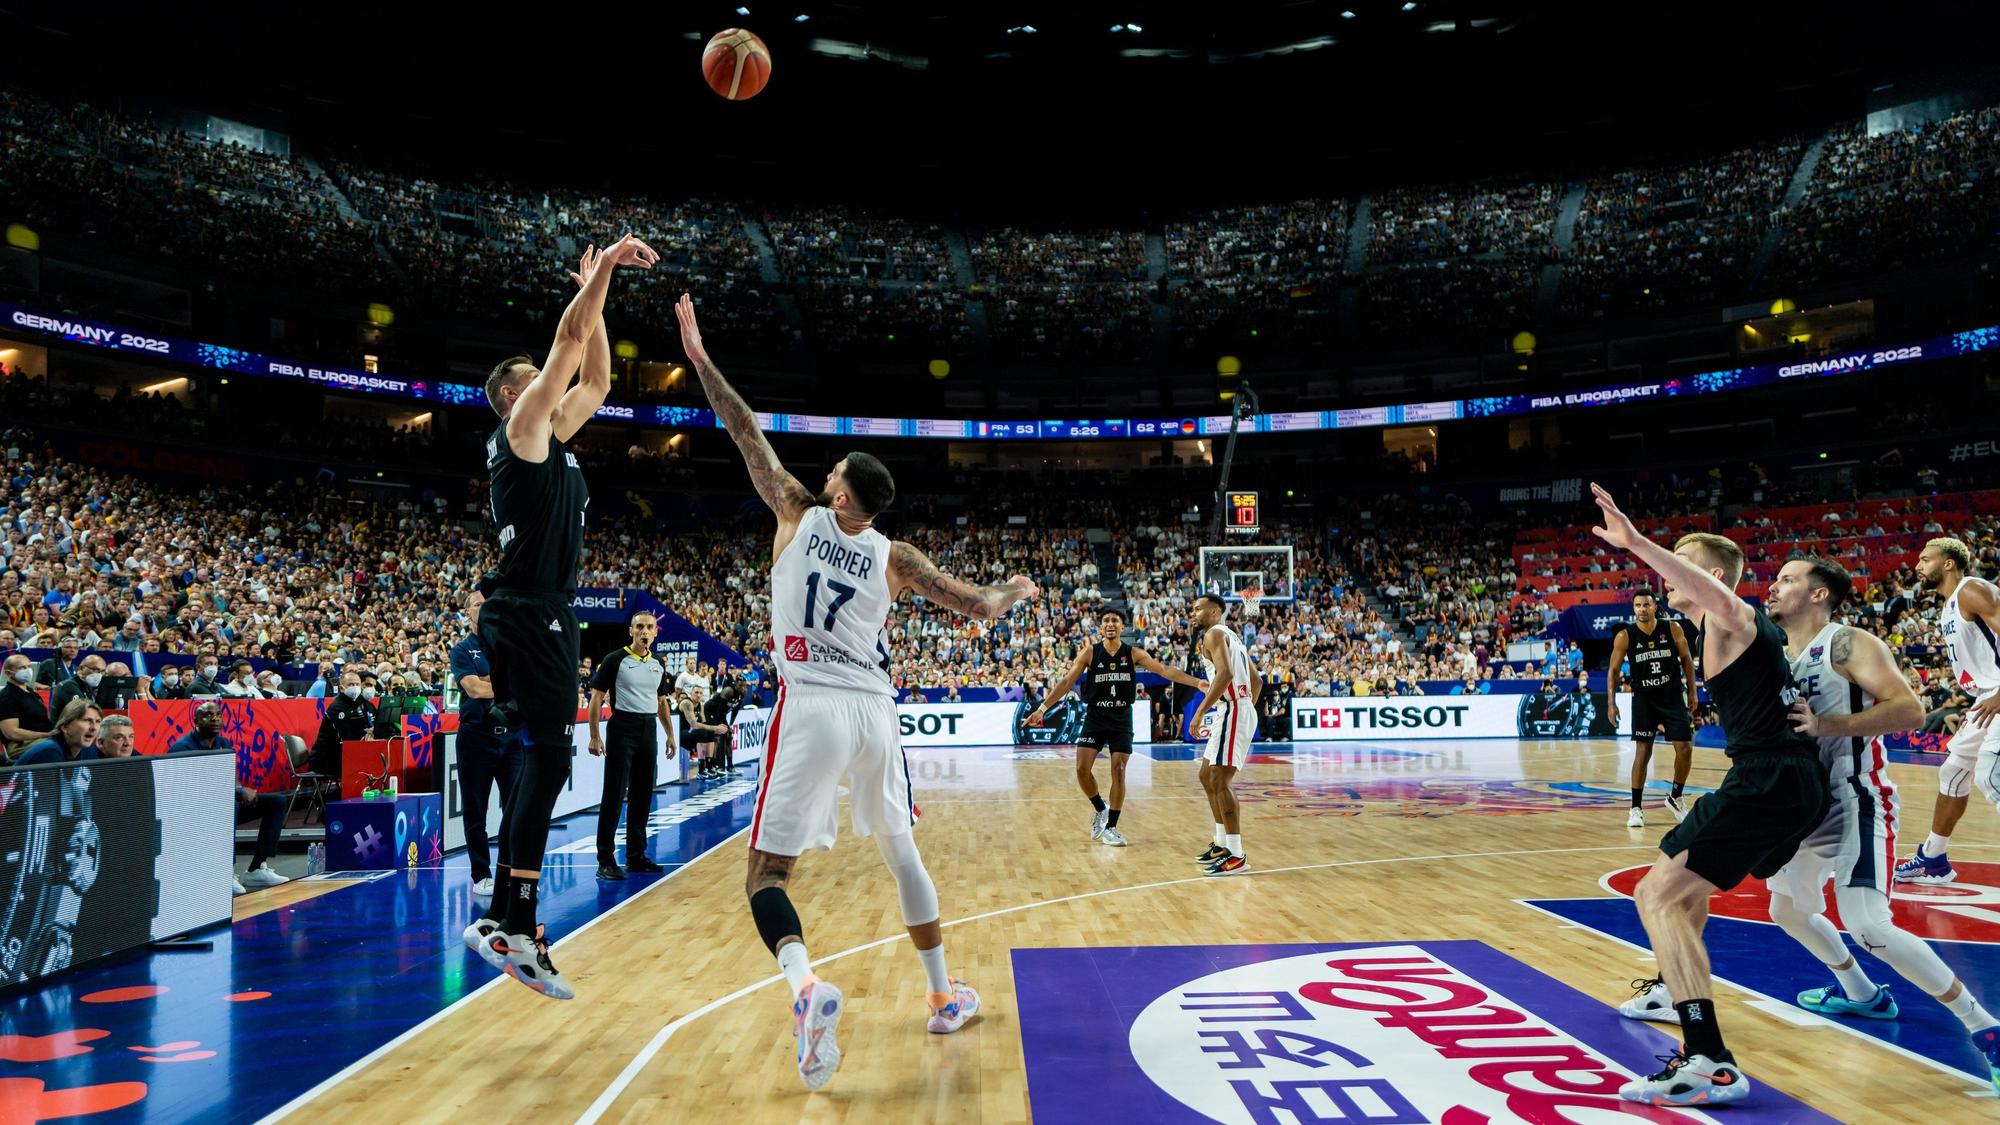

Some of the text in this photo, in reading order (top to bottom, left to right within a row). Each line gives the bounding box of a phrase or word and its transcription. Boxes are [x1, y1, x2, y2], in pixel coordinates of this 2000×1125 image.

[13, 311, 170, 353] GERMANY 2022
[1778, 346, 1922, 378] GERMANY 2022
[269, 362, 408, 391] FIBA EUROBASKET
[1531, 384, 1660, 408] FIBA EUROBASKET
[597, 405, 634, 418] 2022
[991, 424, 1034, 434] FRA 53
[1070, 426, 1100, 436] 5:26
[1136, 421, 1179, 432] 62 GER
[1500, 487, 1530, 503] BRING
[1532, 485, 1551, 500] THE
[1233, 495, 1256, 507] 5:25
[1237, 507, 1254, 525] 10
[806, 533, 872, 580] POIRIER
[569, 596, 627, 608] ASKE
[805, 571, 857, 633] 17
[656, 640, 699, 652] BRING THE
[1635, 648, 1672, 662] DEUTSCHLAND
[1649, 661, 1661, 674] 32
[1095, 672, 1132, 683] DEUTSCHLAND
[1642, 678, 1661, 687] ING
[1110, 684, 1116, 697] 4
[1344, 706, 1469, 728] TISSOT
[739, 720, 765, 750] TISSOT
